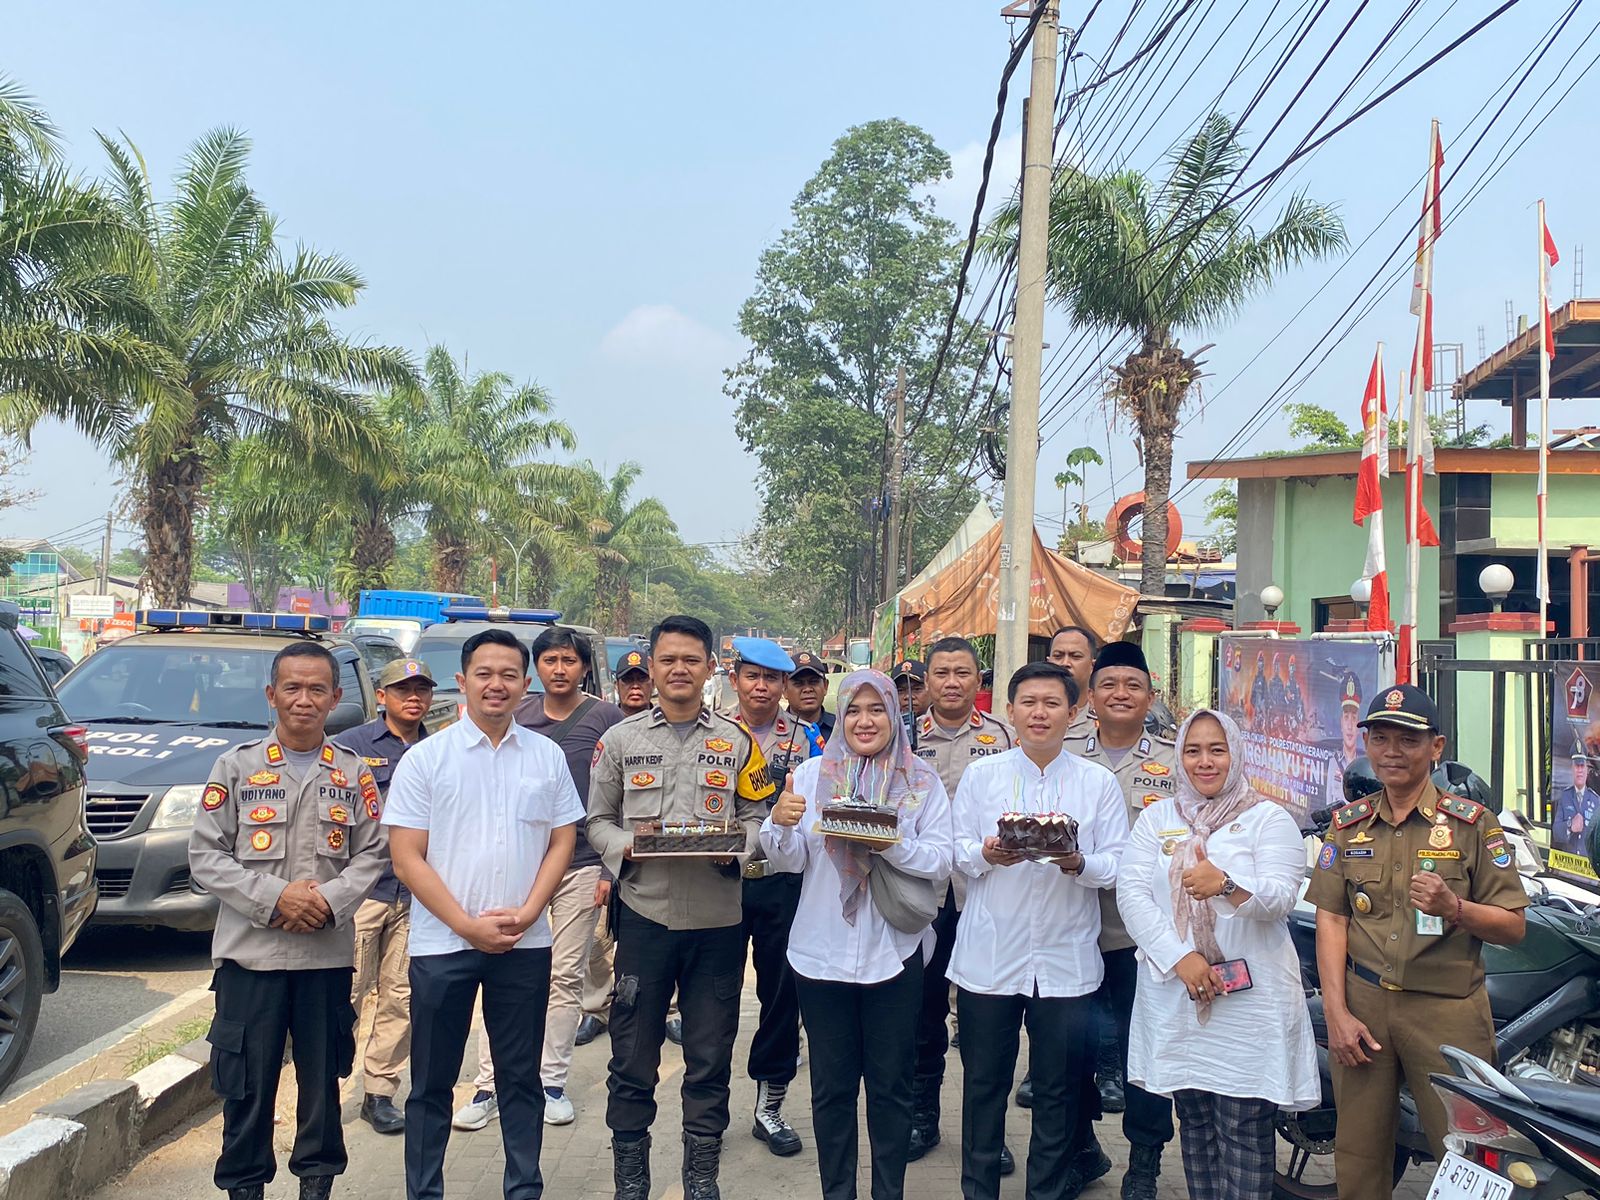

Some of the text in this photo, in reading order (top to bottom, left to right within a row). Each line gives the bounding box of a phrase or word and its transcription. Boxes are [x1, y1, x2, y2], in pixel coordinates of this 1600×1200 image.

[1570, 675, 1586, 709] 78
[86, 731, 230, 749] POL PP
[88, 745, 174, 759] ROLI
[697, 754, 736, 767] POLRI
[624, 755, 645, 767] HARRY
[1303, 756, 1325, 786] TNI
[1133, 777, 1172, 790] POLRI
[319, 786, 357, 803] POLRI
[1440, 1158, 1451, 1177] B
[1452, 1165, 1480, 1194] 6791
